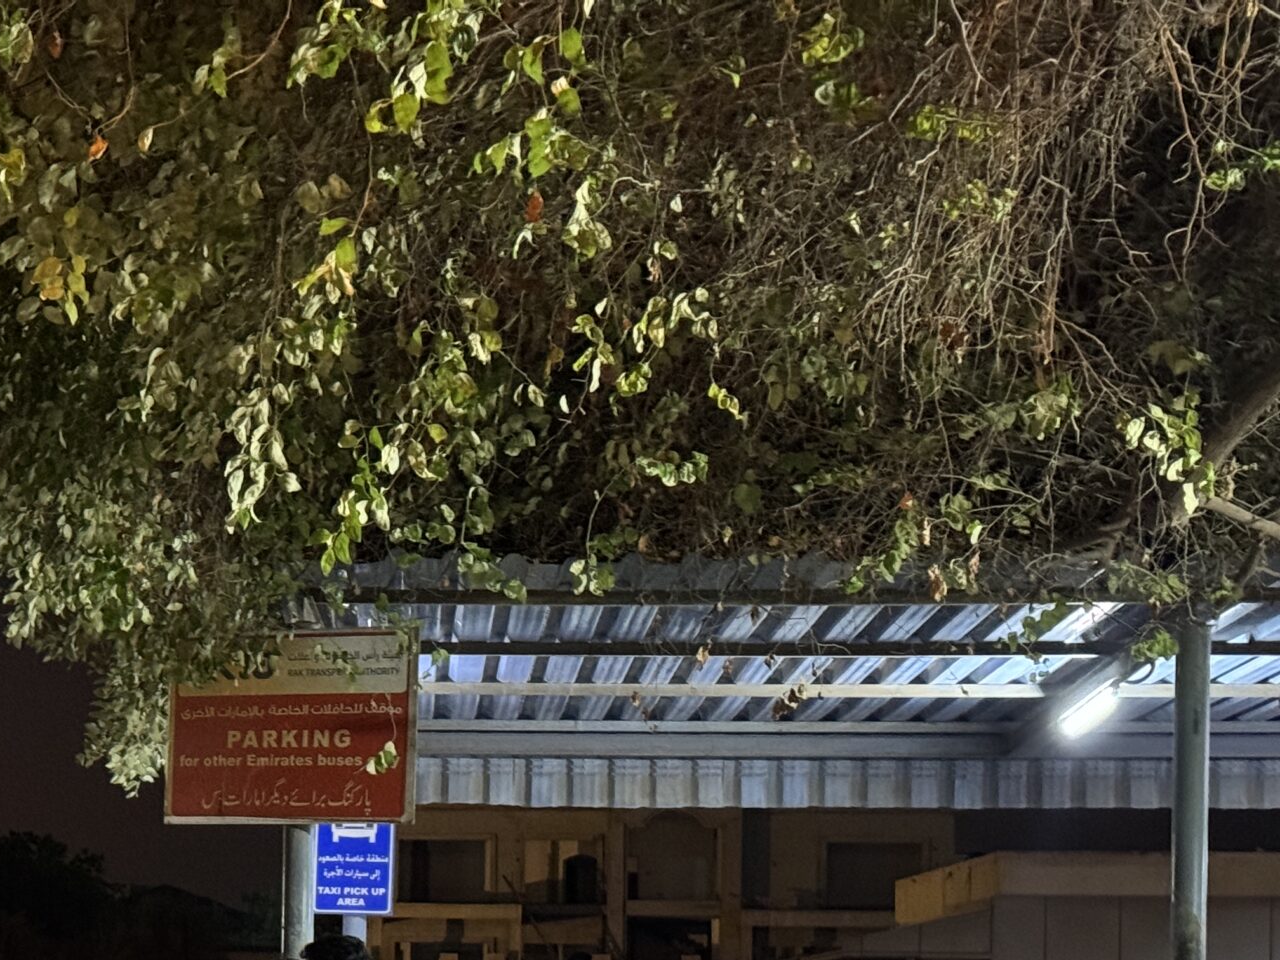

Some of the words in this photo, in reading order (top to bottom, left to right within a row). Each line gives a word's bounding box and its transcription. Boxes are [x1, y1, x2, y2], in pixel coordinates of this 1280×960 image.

[227, 729, 352, 748] PARKING
[179, 754, 199, 767] for
[203, 754, 241, 767] other
[246, 754, 313, 767] Emirates
[317, 753, 363, 766] buses
[317, 886, 341, 895] TAXI
[344, 886, 369, 896] PICK
[371, 887, 386, 896] UP
[336, 897, 366, 906] AREA
